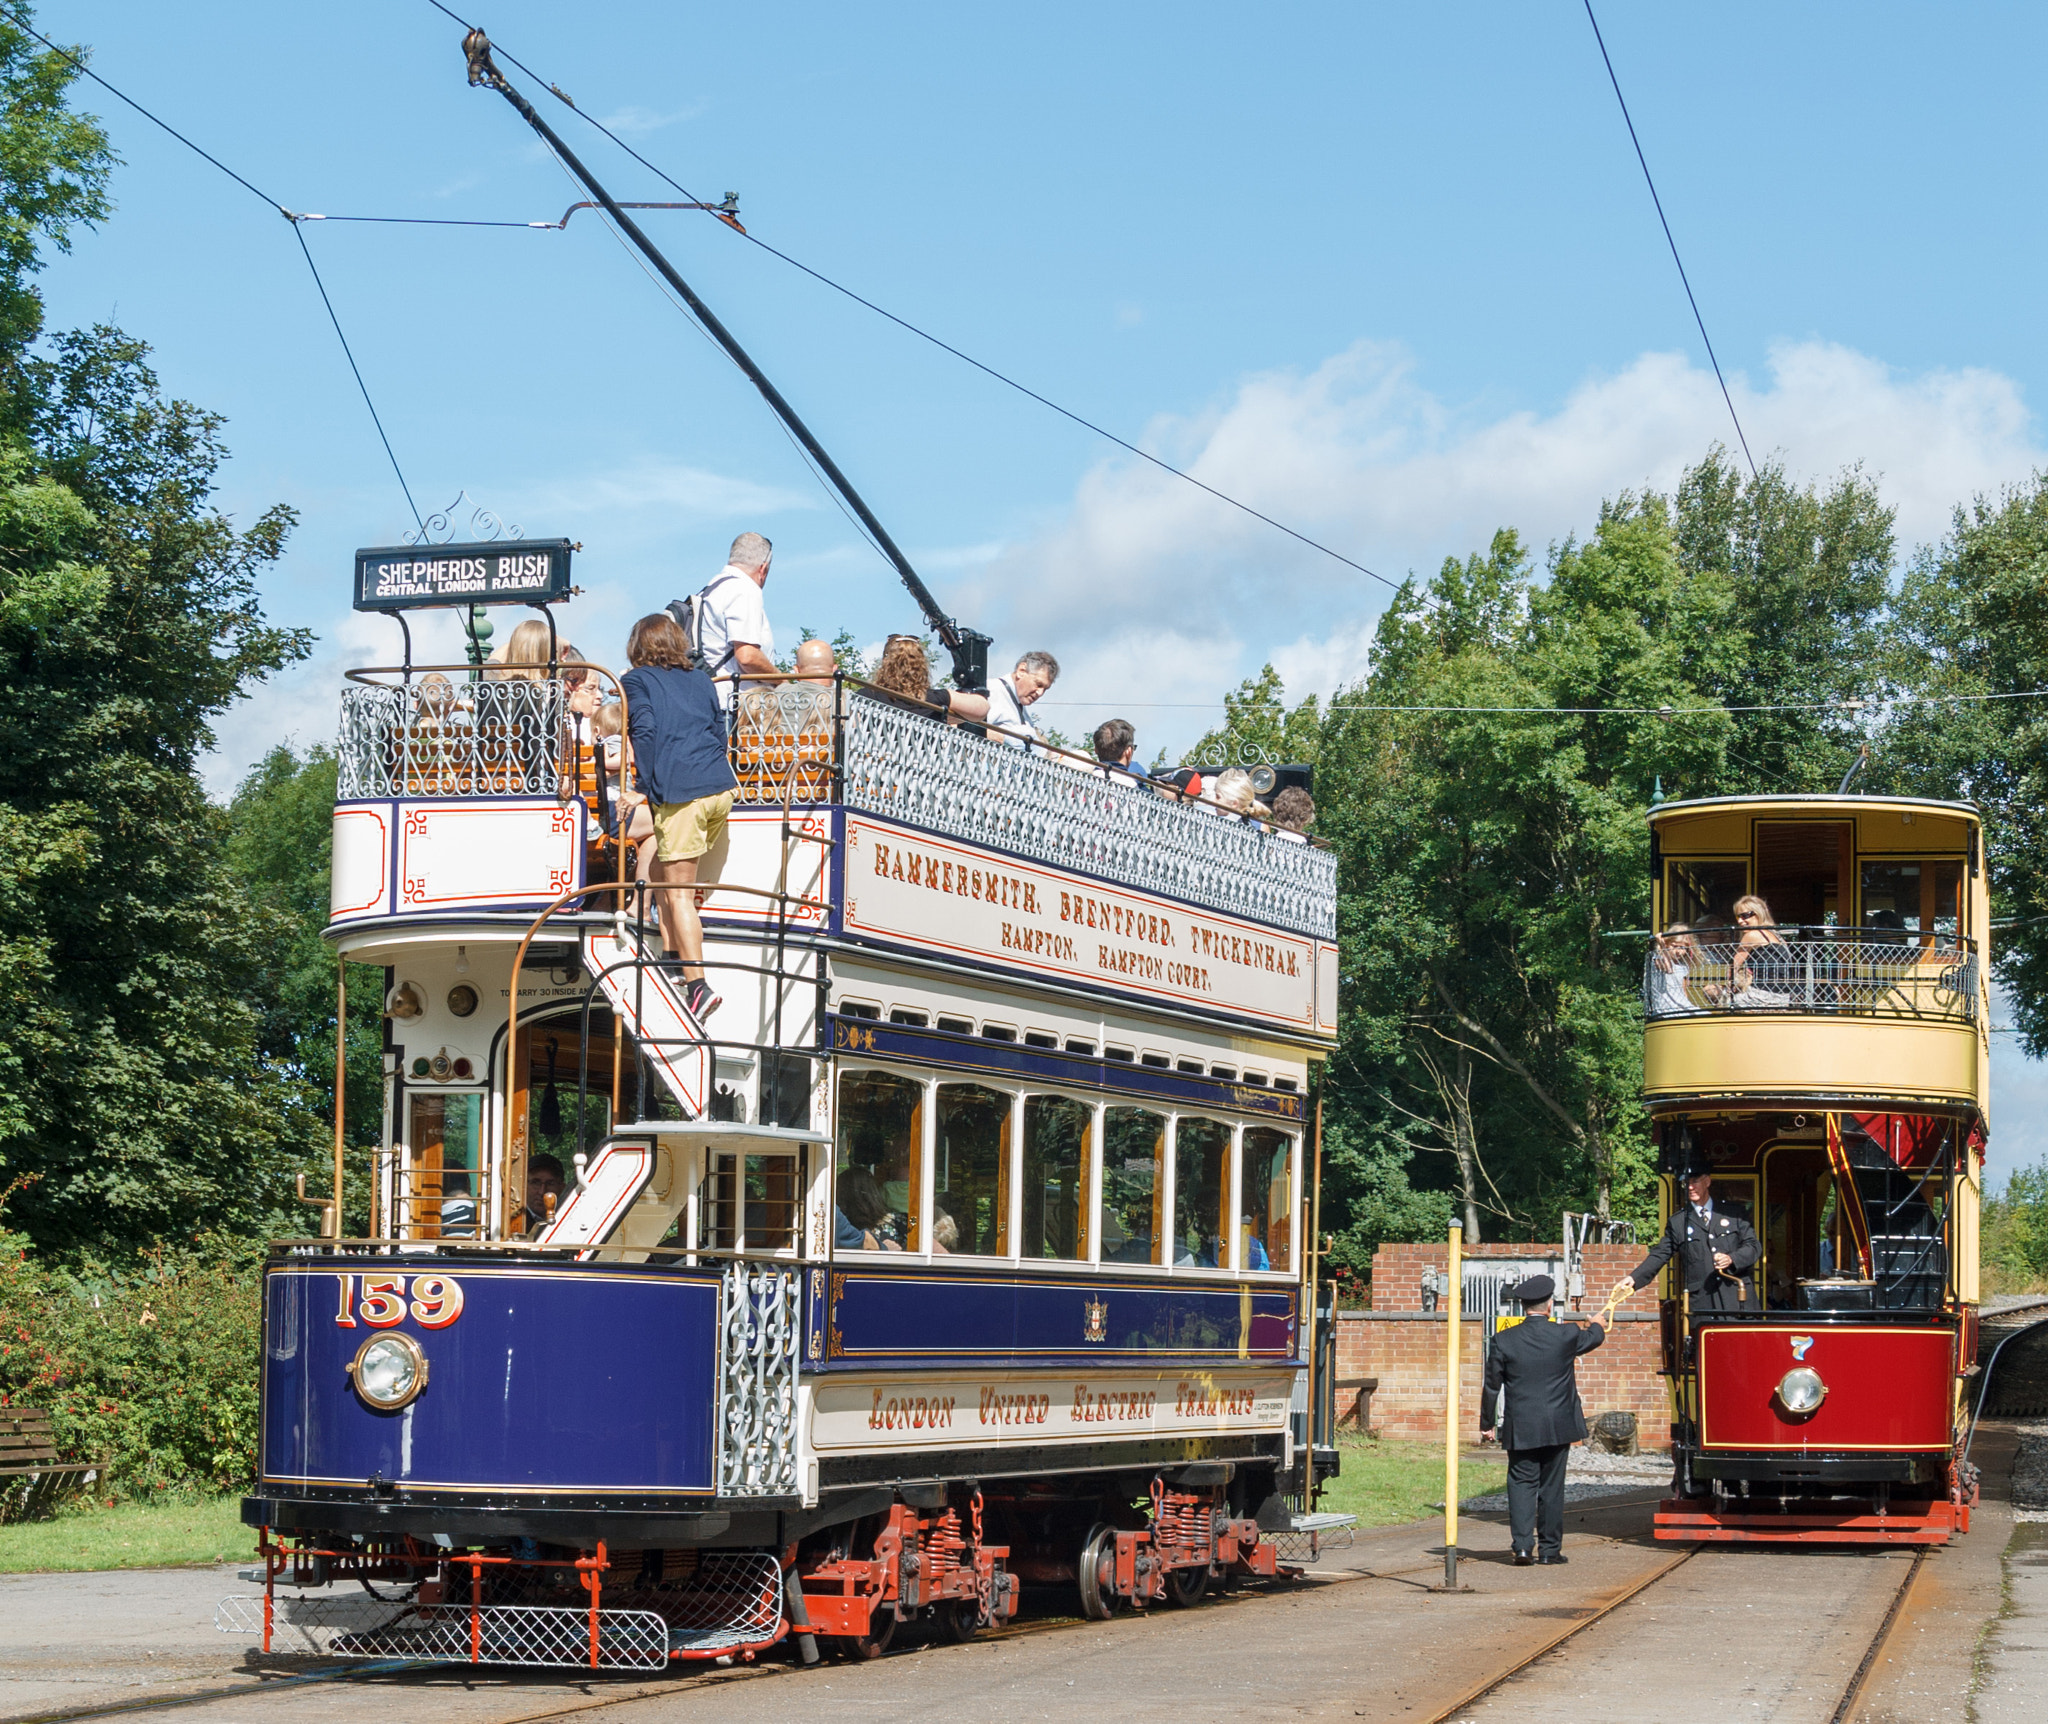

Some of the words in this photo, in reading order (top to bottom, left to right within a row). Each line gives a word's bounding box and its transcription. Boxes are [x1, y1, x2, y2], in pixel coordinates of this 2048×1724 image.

[378, 558, 486, 585] SHEPHERDS
[498, 555, 548, 577] BUSH
[376, 583, 432, 597] CENTRAL
[437, 578, 486, 593] LONDON
[492, 576, 547, 590] RAILWAY
[1098, 944, 1163, 980] HAMPTON
[514, 988, 538, 997] ARRY
[540, 988, 550, 996] 30
[552, 987, 576, 995] INSIDE
[335, 1274, 465, 1331] 159
[1790, 1335, 1814, 1360] 7
[868, 1387, 955, 1430] LONDON
[979, 1386, 1049, 1425] UNITED
[1071, 1384, 1156, 1422] ELECTRIC
[1175, 1382, 1255, 1417] TRAMWAYS
